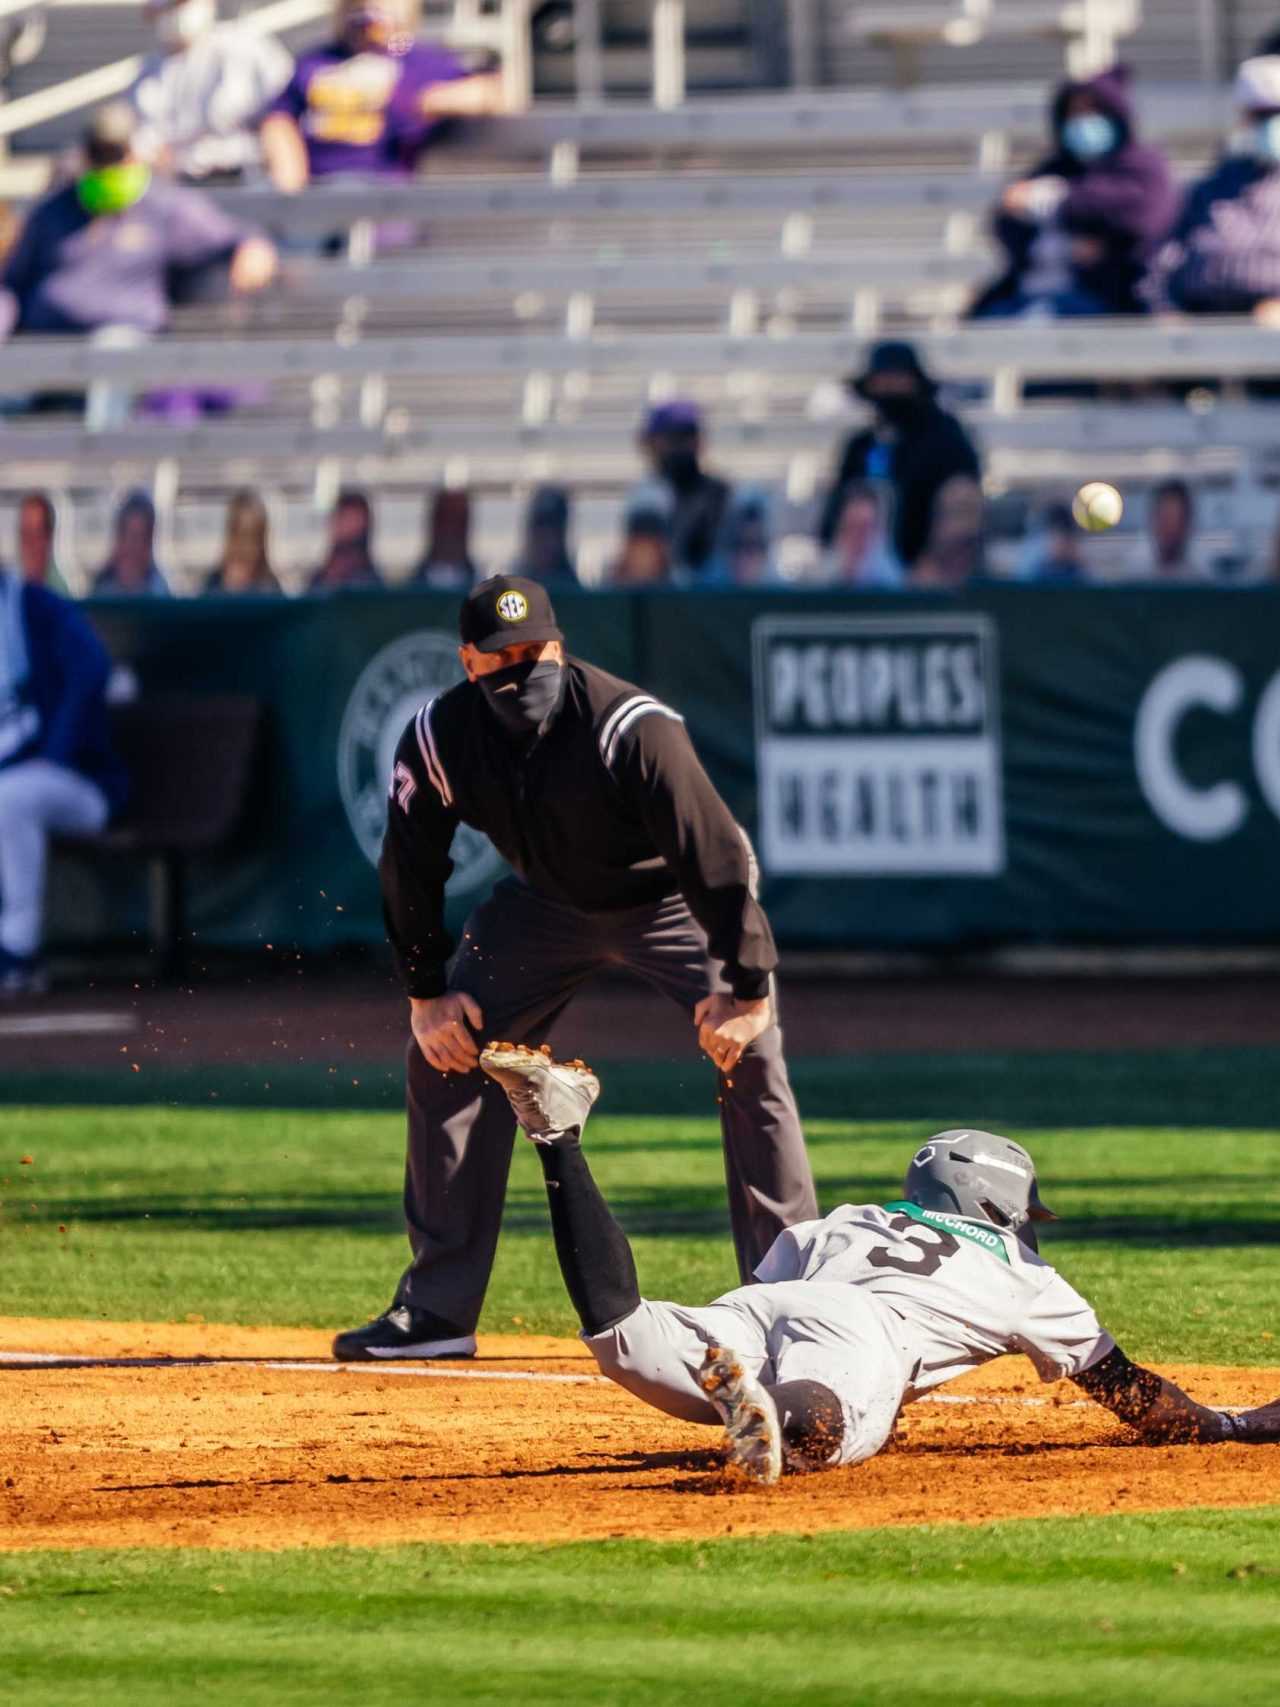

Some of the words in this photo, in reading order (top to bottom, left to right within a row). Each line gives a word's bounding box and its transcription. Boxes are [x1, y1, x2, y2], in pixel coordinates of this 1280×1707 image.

[771, 645, 984, 727] PEOPLES
[777, 768, 980, 844] HEALTH
[866, 1216, 961, 1277] 3
